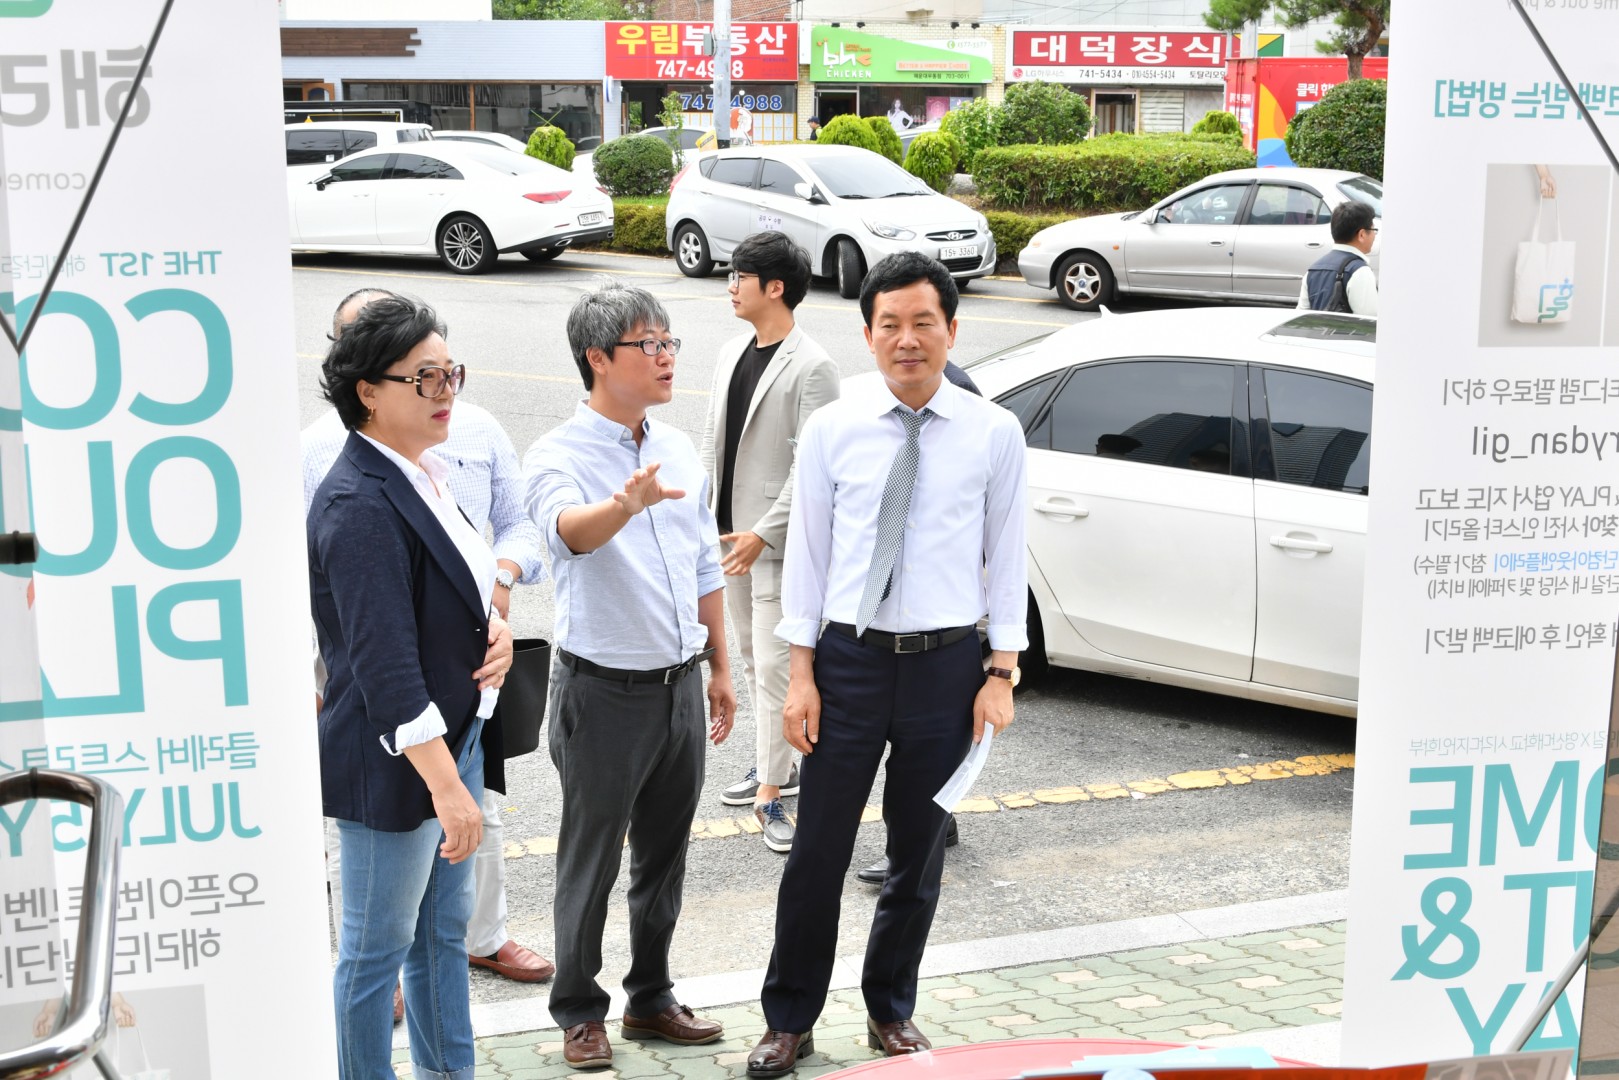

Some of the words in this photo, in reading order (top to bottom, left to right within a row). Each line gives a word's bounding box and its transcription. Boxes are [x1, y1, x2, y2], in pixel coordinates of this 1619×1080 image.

[1030, 35, 1221, 64] 대덕장식
[656, 60, 743, 78] 747-498
[827, 69, 872, 78] CHICKEN
[1079, 69, 1122, 78] 741-5434
[1296, 83, 1318, 97] 클릭
[680, 94, 783, 111] 7474988
[958, 247, 975, 257] 3360
